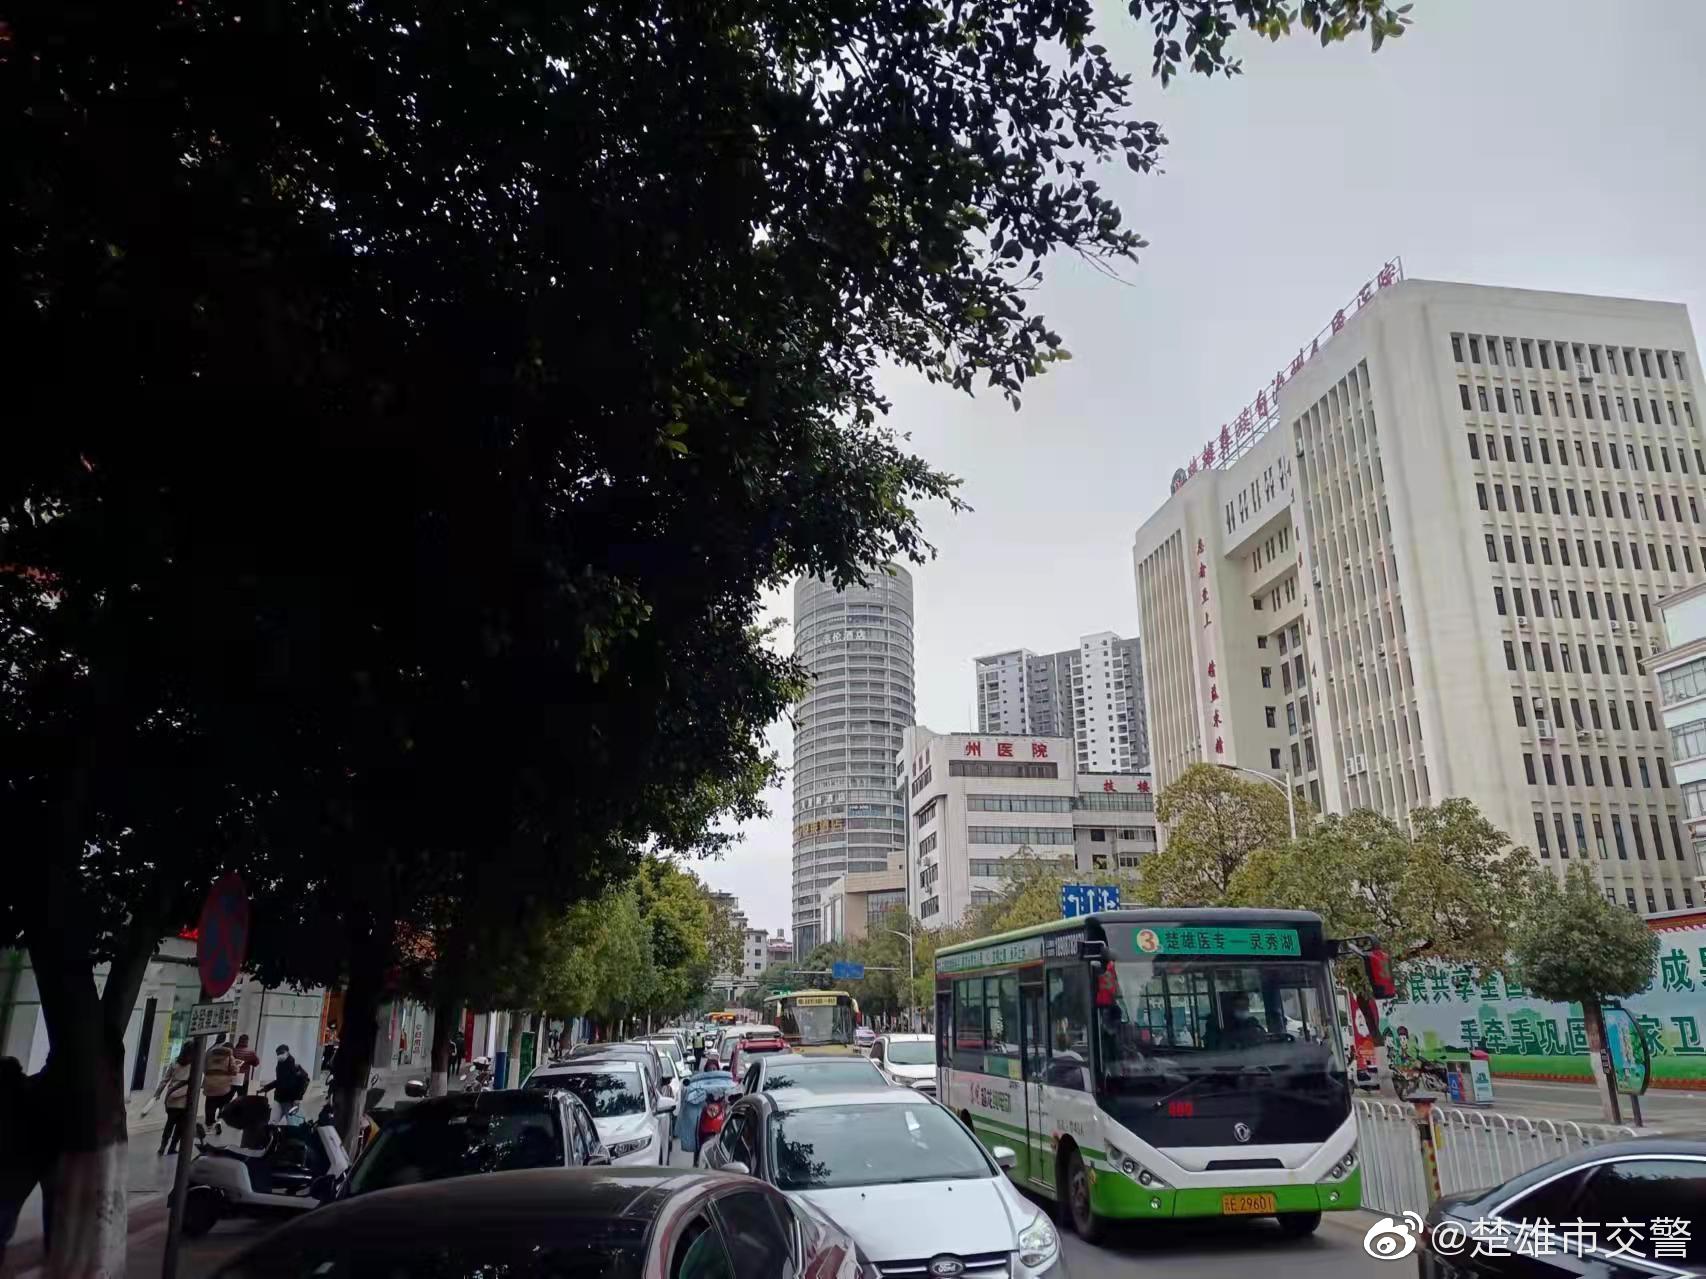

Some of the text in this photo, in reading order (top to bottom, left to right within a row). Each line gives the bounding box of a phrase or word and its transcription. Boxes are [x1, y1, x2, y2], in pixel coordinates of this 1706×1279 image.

[964, 741, 1049, 758] 州医院
[1139, 930, 1155, 951] 3
[1659, 947, 1706, 992] 成
[937, 1262, 956, 1273] Ford
